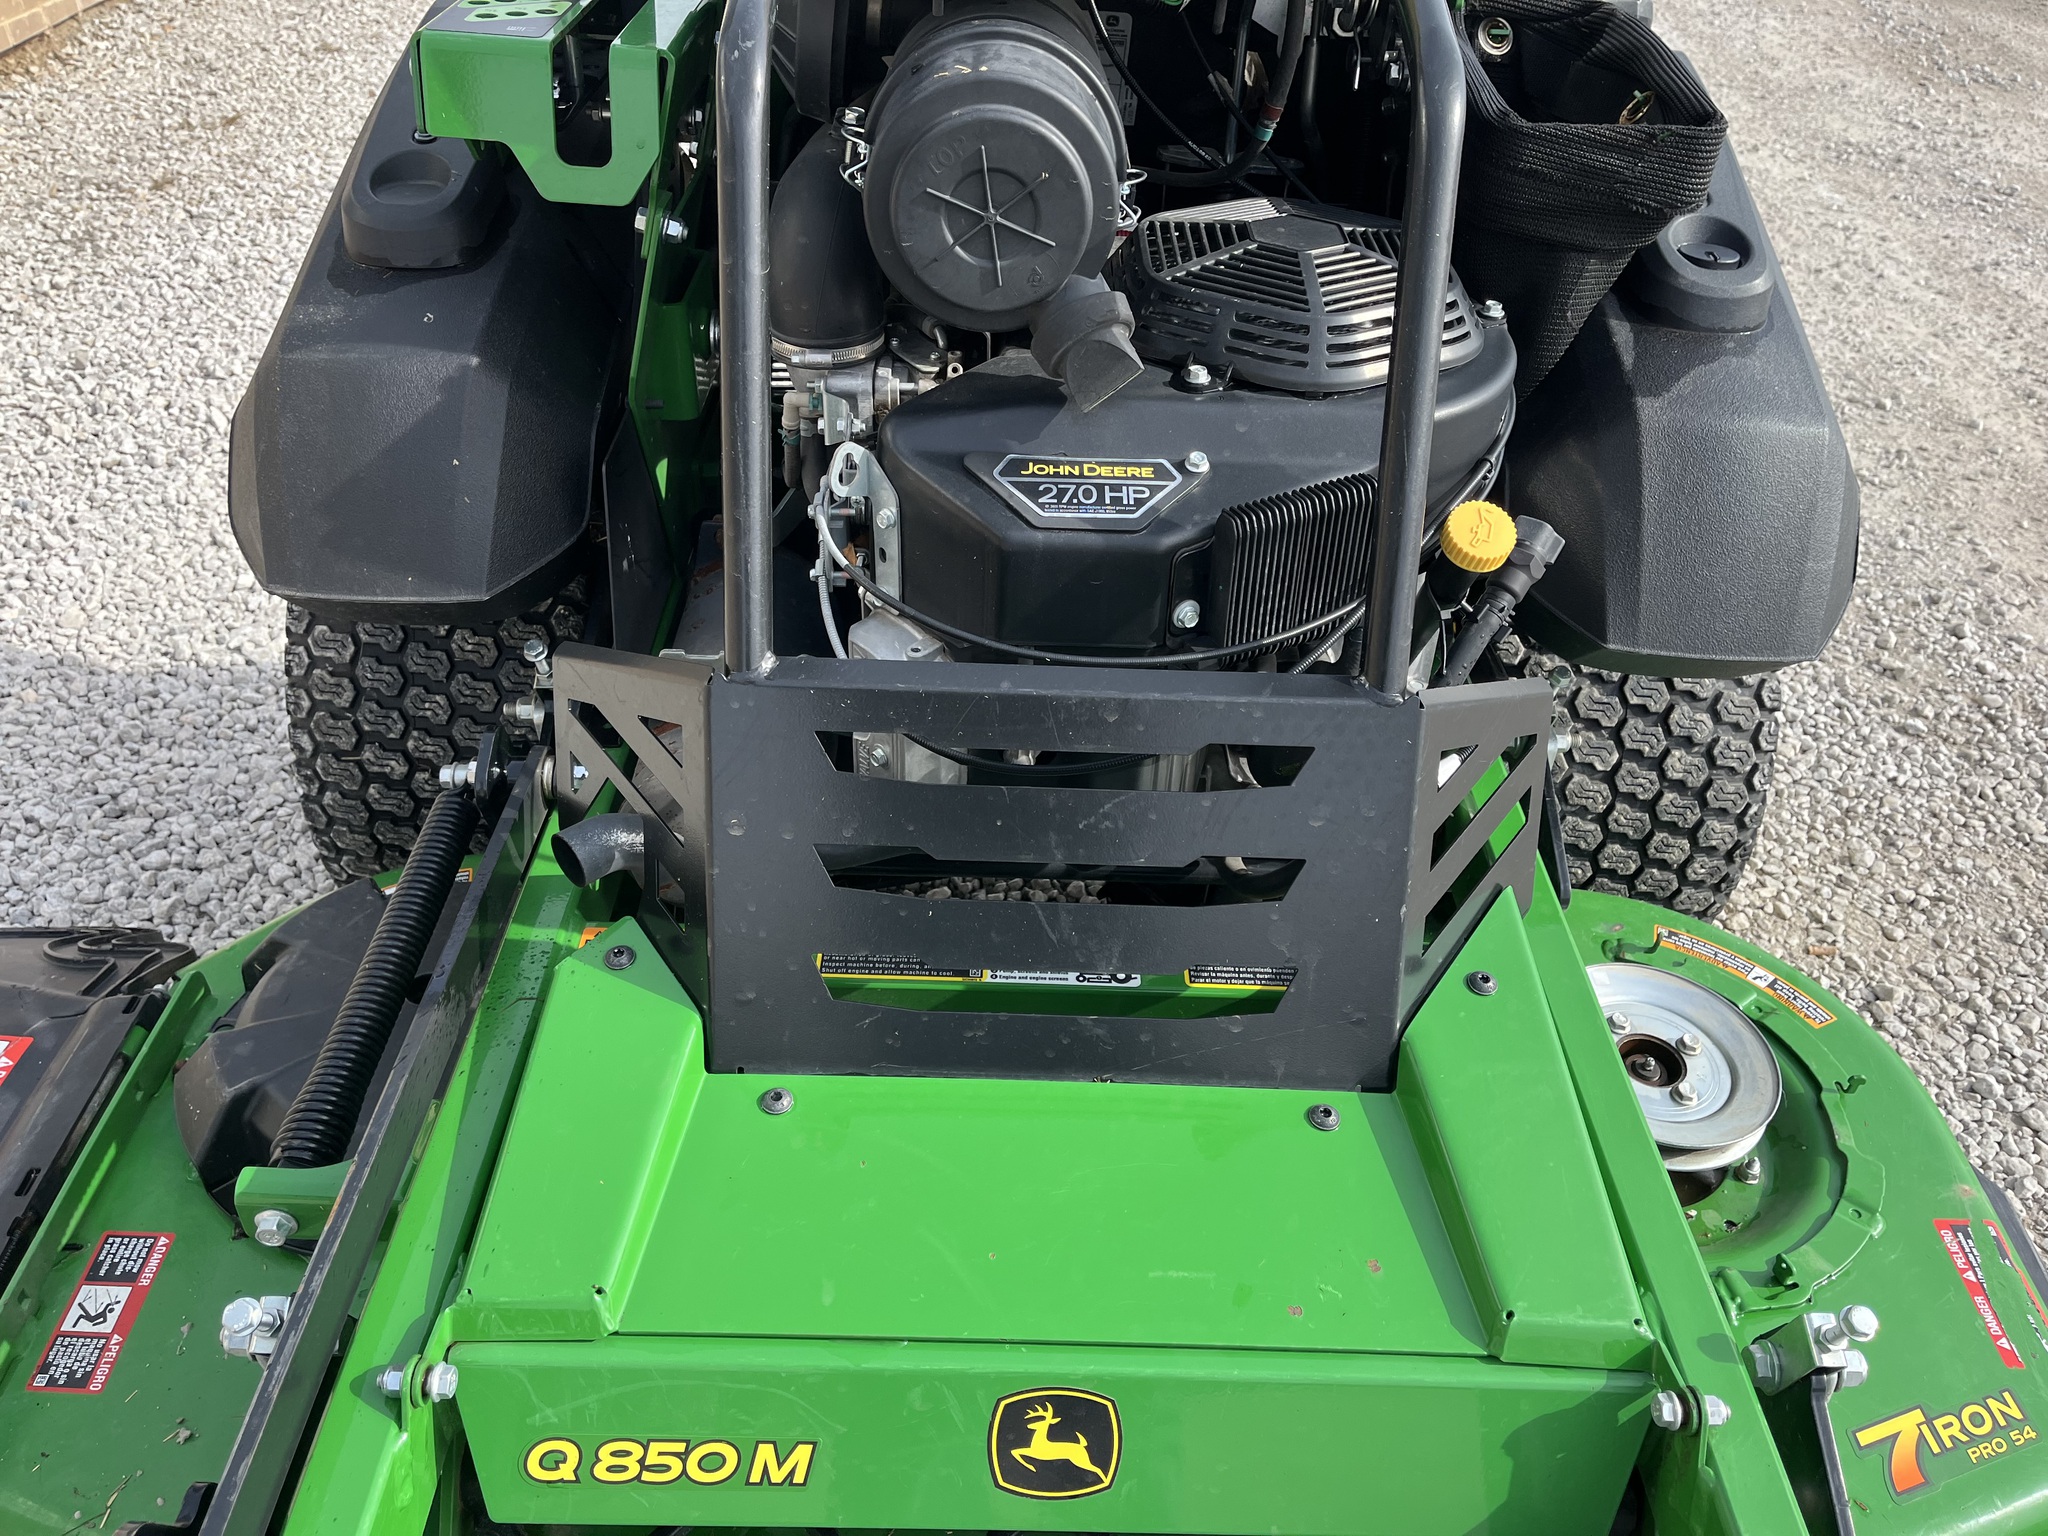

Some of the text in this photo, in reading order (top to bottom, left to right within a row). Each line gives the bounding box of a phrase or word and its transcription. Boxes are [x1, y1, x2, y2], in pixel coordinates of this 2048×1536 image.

[1021, 462, 1154, 478] JOHN DEERE
[1038, 484, 1151, 505] 27.0 HP
[138, 1246, 166, 1285] DANGER
[1940, 1229, 1968, 1269] PELIGRO
[1974, 1295, 2002, 1335] DANGER
[89, 1345, 119, 1390] PELIGRO
[523, 1436, 818, 1487] Q 850 M
[1966, 1425, 2038, 1464] PRO 54
